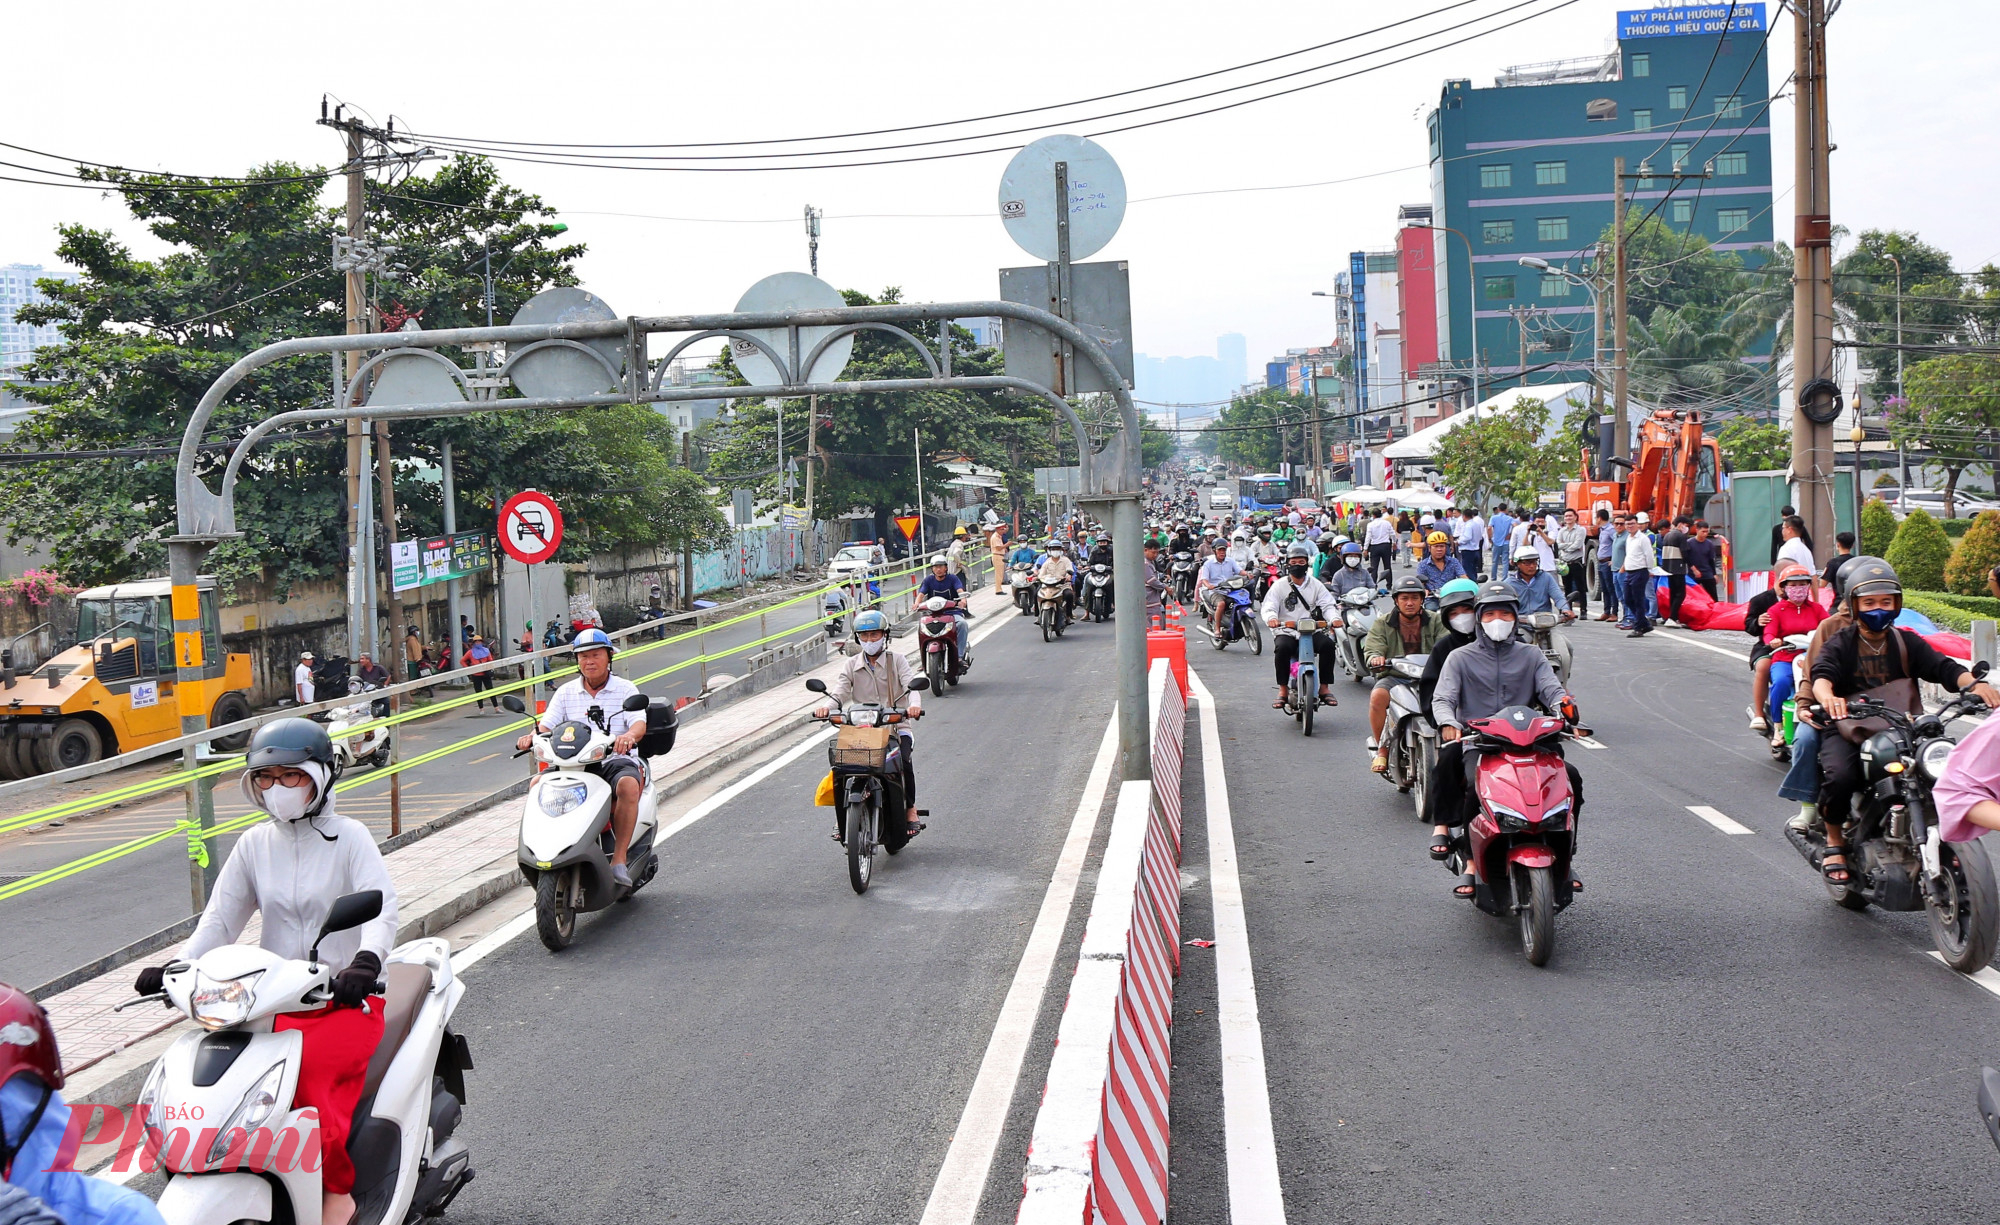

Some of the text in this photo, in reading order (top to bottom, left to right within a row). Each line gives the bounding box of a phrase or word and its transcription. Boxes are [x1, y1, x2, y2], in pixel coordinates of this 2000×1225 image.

[1630, 11, 1647, 23] MỸ
[1651, 9, 1684, 22] PHẨM
[1687, 7, 1726, 20] HƯỚNG
[1624, 18, 1760, 36] THƯƠNG HIỆU QUỐC GIA
[423, 547, 451, 566] BLACK
[426, 561, 450, 579] WEEK
